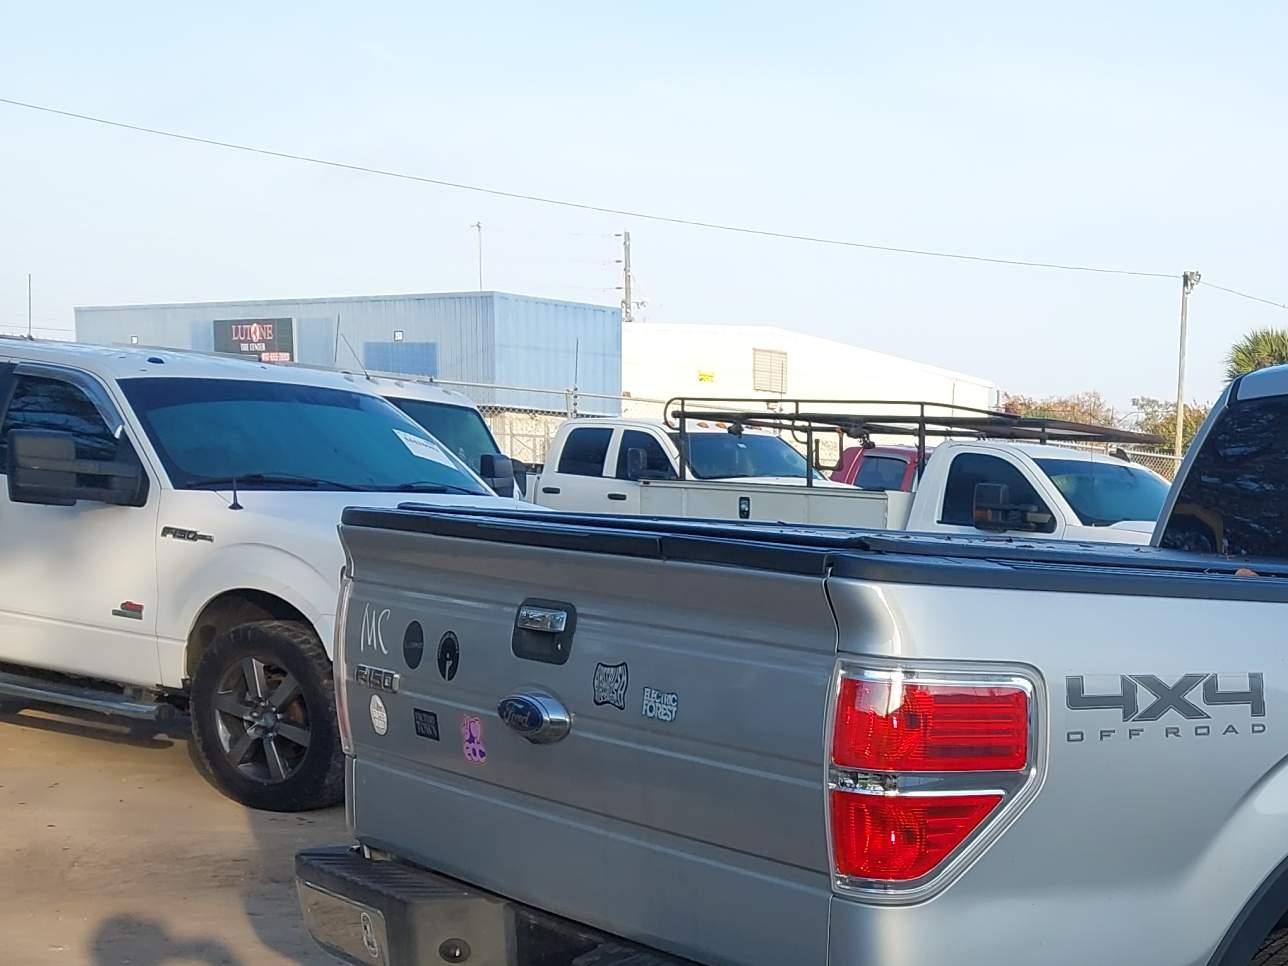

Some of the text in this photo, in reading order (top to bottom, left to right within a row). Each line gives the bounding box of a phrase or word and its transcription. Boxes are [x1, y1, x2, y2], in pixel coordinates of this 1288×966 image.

[643, 687, 677, 706] ELECTRIC
[503, 700, 531, 728] Ford
[642, 700, 677, 721] FOREST
